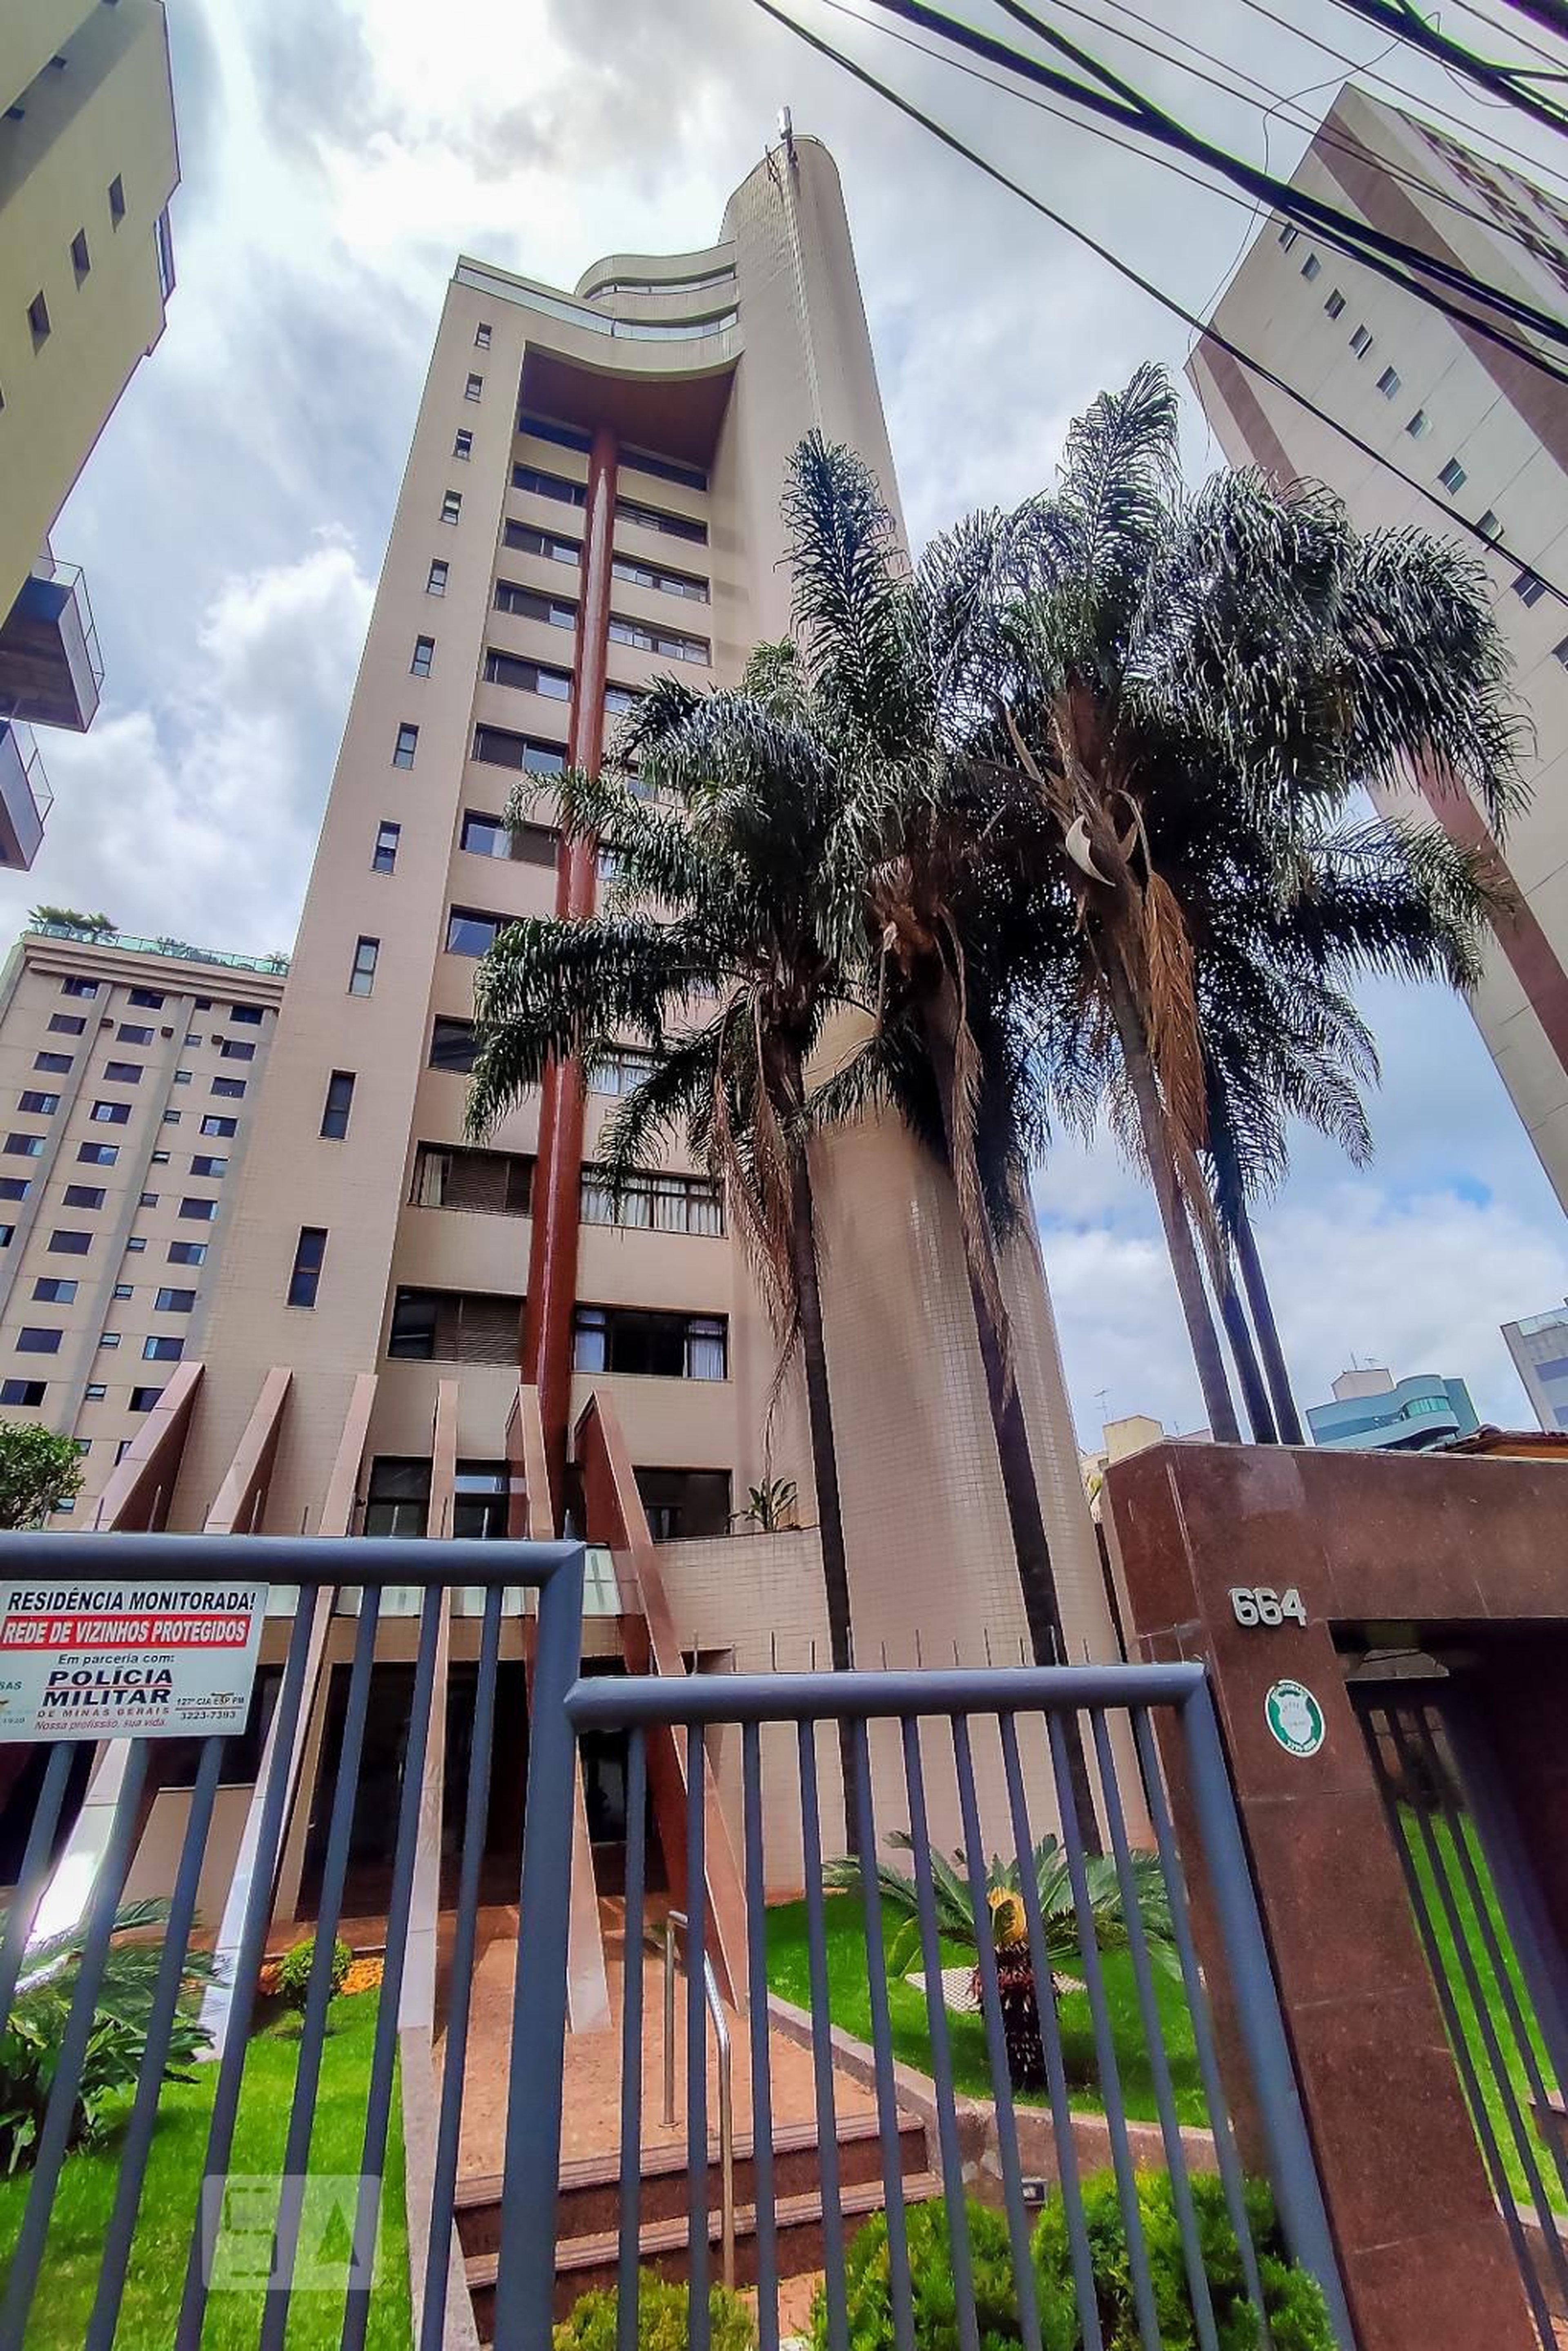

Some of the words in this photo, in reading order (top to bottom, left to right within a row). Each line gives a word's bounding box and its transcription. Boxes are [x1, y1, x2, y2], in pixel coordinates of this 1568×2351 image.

[8, 1587, 124, 1610] RESIDÊNCIA
[129, 1592, 256, 1610] MONITORADA!
[1228, 1588, 1307, 1627] 664
[3, 1622, 49, 1644] REDE
[49, 1621, 74, 1644] DE
[76, 1620, 151, 1643] VIZINHOS
[151, 1620, 246, 1642] PROTEGIDOS
[58, 1654, 78, 1665] Em
[82, 1654, 139, 1666] parceria
[143, 1654, 175, 1663] com:
[48, 1666, 172, 1686] POLÍCIA
[42, 1689, 170, 1706] MILITAR
[62, 1708, 110, 1717] MINAS
[117, 1707, 169, 1715] GERAIS
[35, 1721, 67, 1730] Nossa
